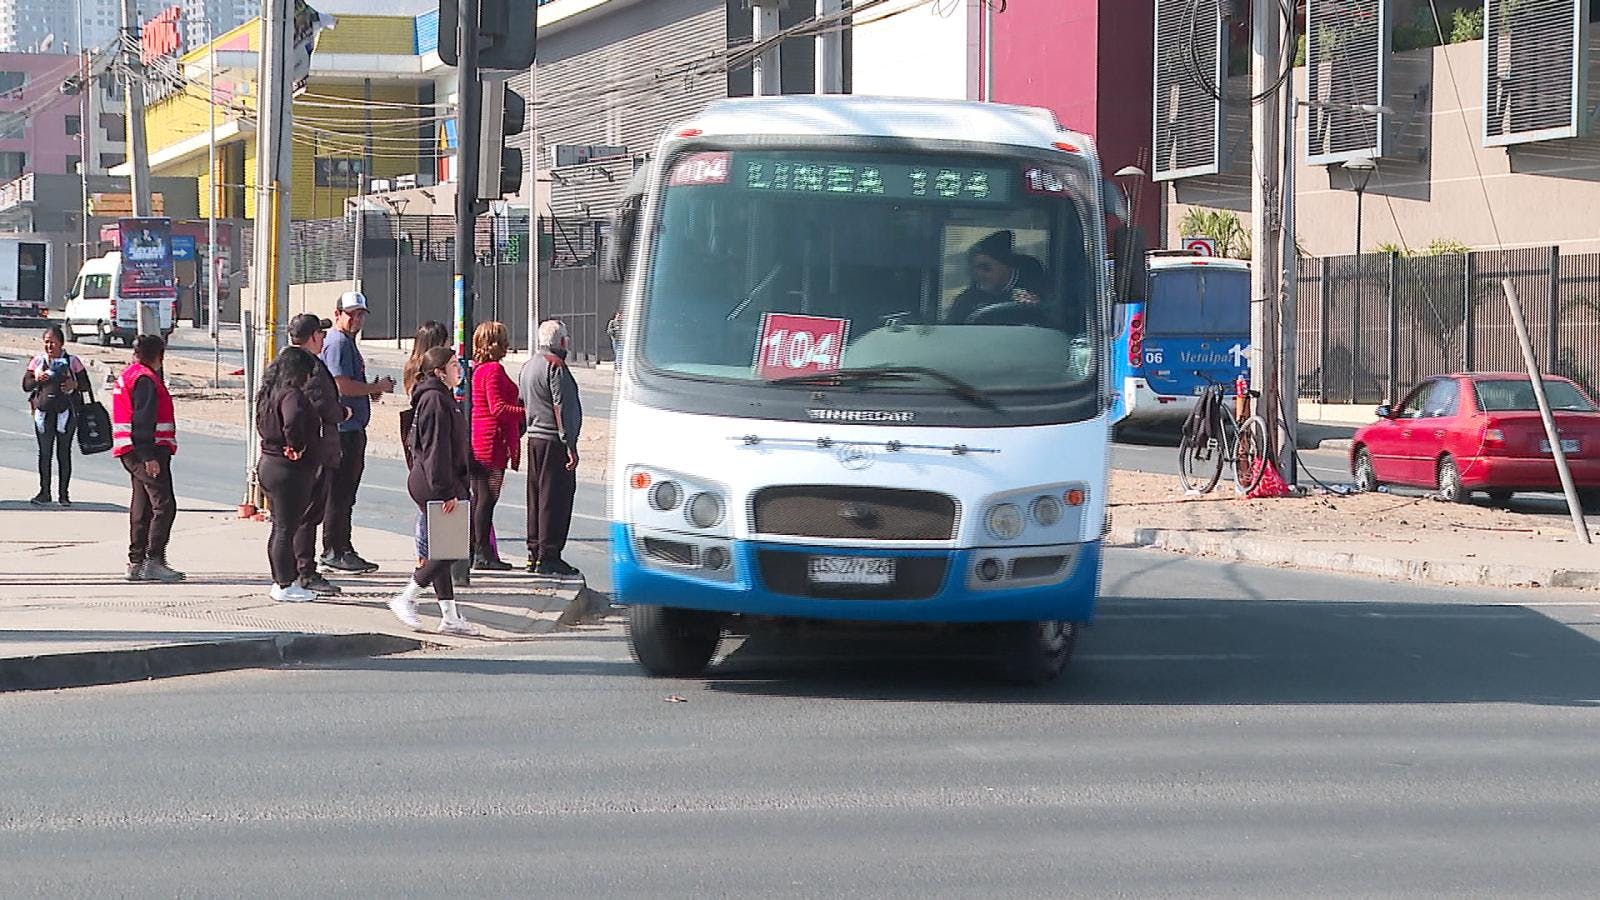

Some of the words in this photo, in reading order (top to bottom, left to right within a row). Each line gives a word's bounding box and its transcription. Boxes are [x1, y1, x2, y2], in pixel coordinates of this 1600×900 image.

[748, 160, 885, 195] LINEA
[909, 168, 990, 198] 104
[764, 329, 840, 371] 104
[1145, 352, 1163, 364] 06
